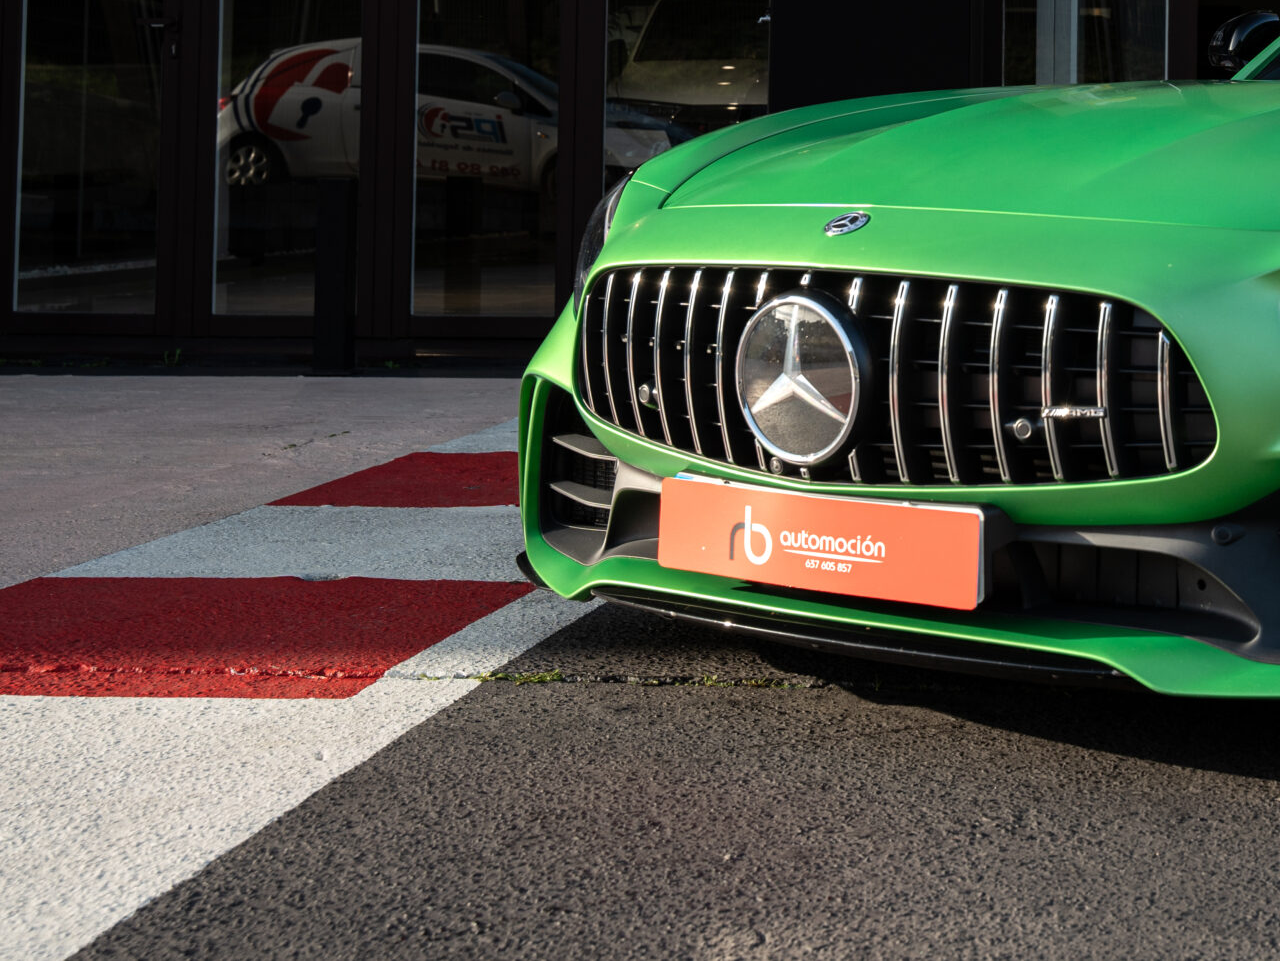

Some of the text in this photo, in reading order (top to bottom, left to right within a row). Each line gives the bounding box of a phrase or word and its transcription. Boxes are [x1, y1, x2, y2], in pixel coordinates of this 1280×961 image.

[729, 505, 773, 565] rb
[780, 530, 886, 558] automoción
[805, 558, 853, 573] 637 605 857
